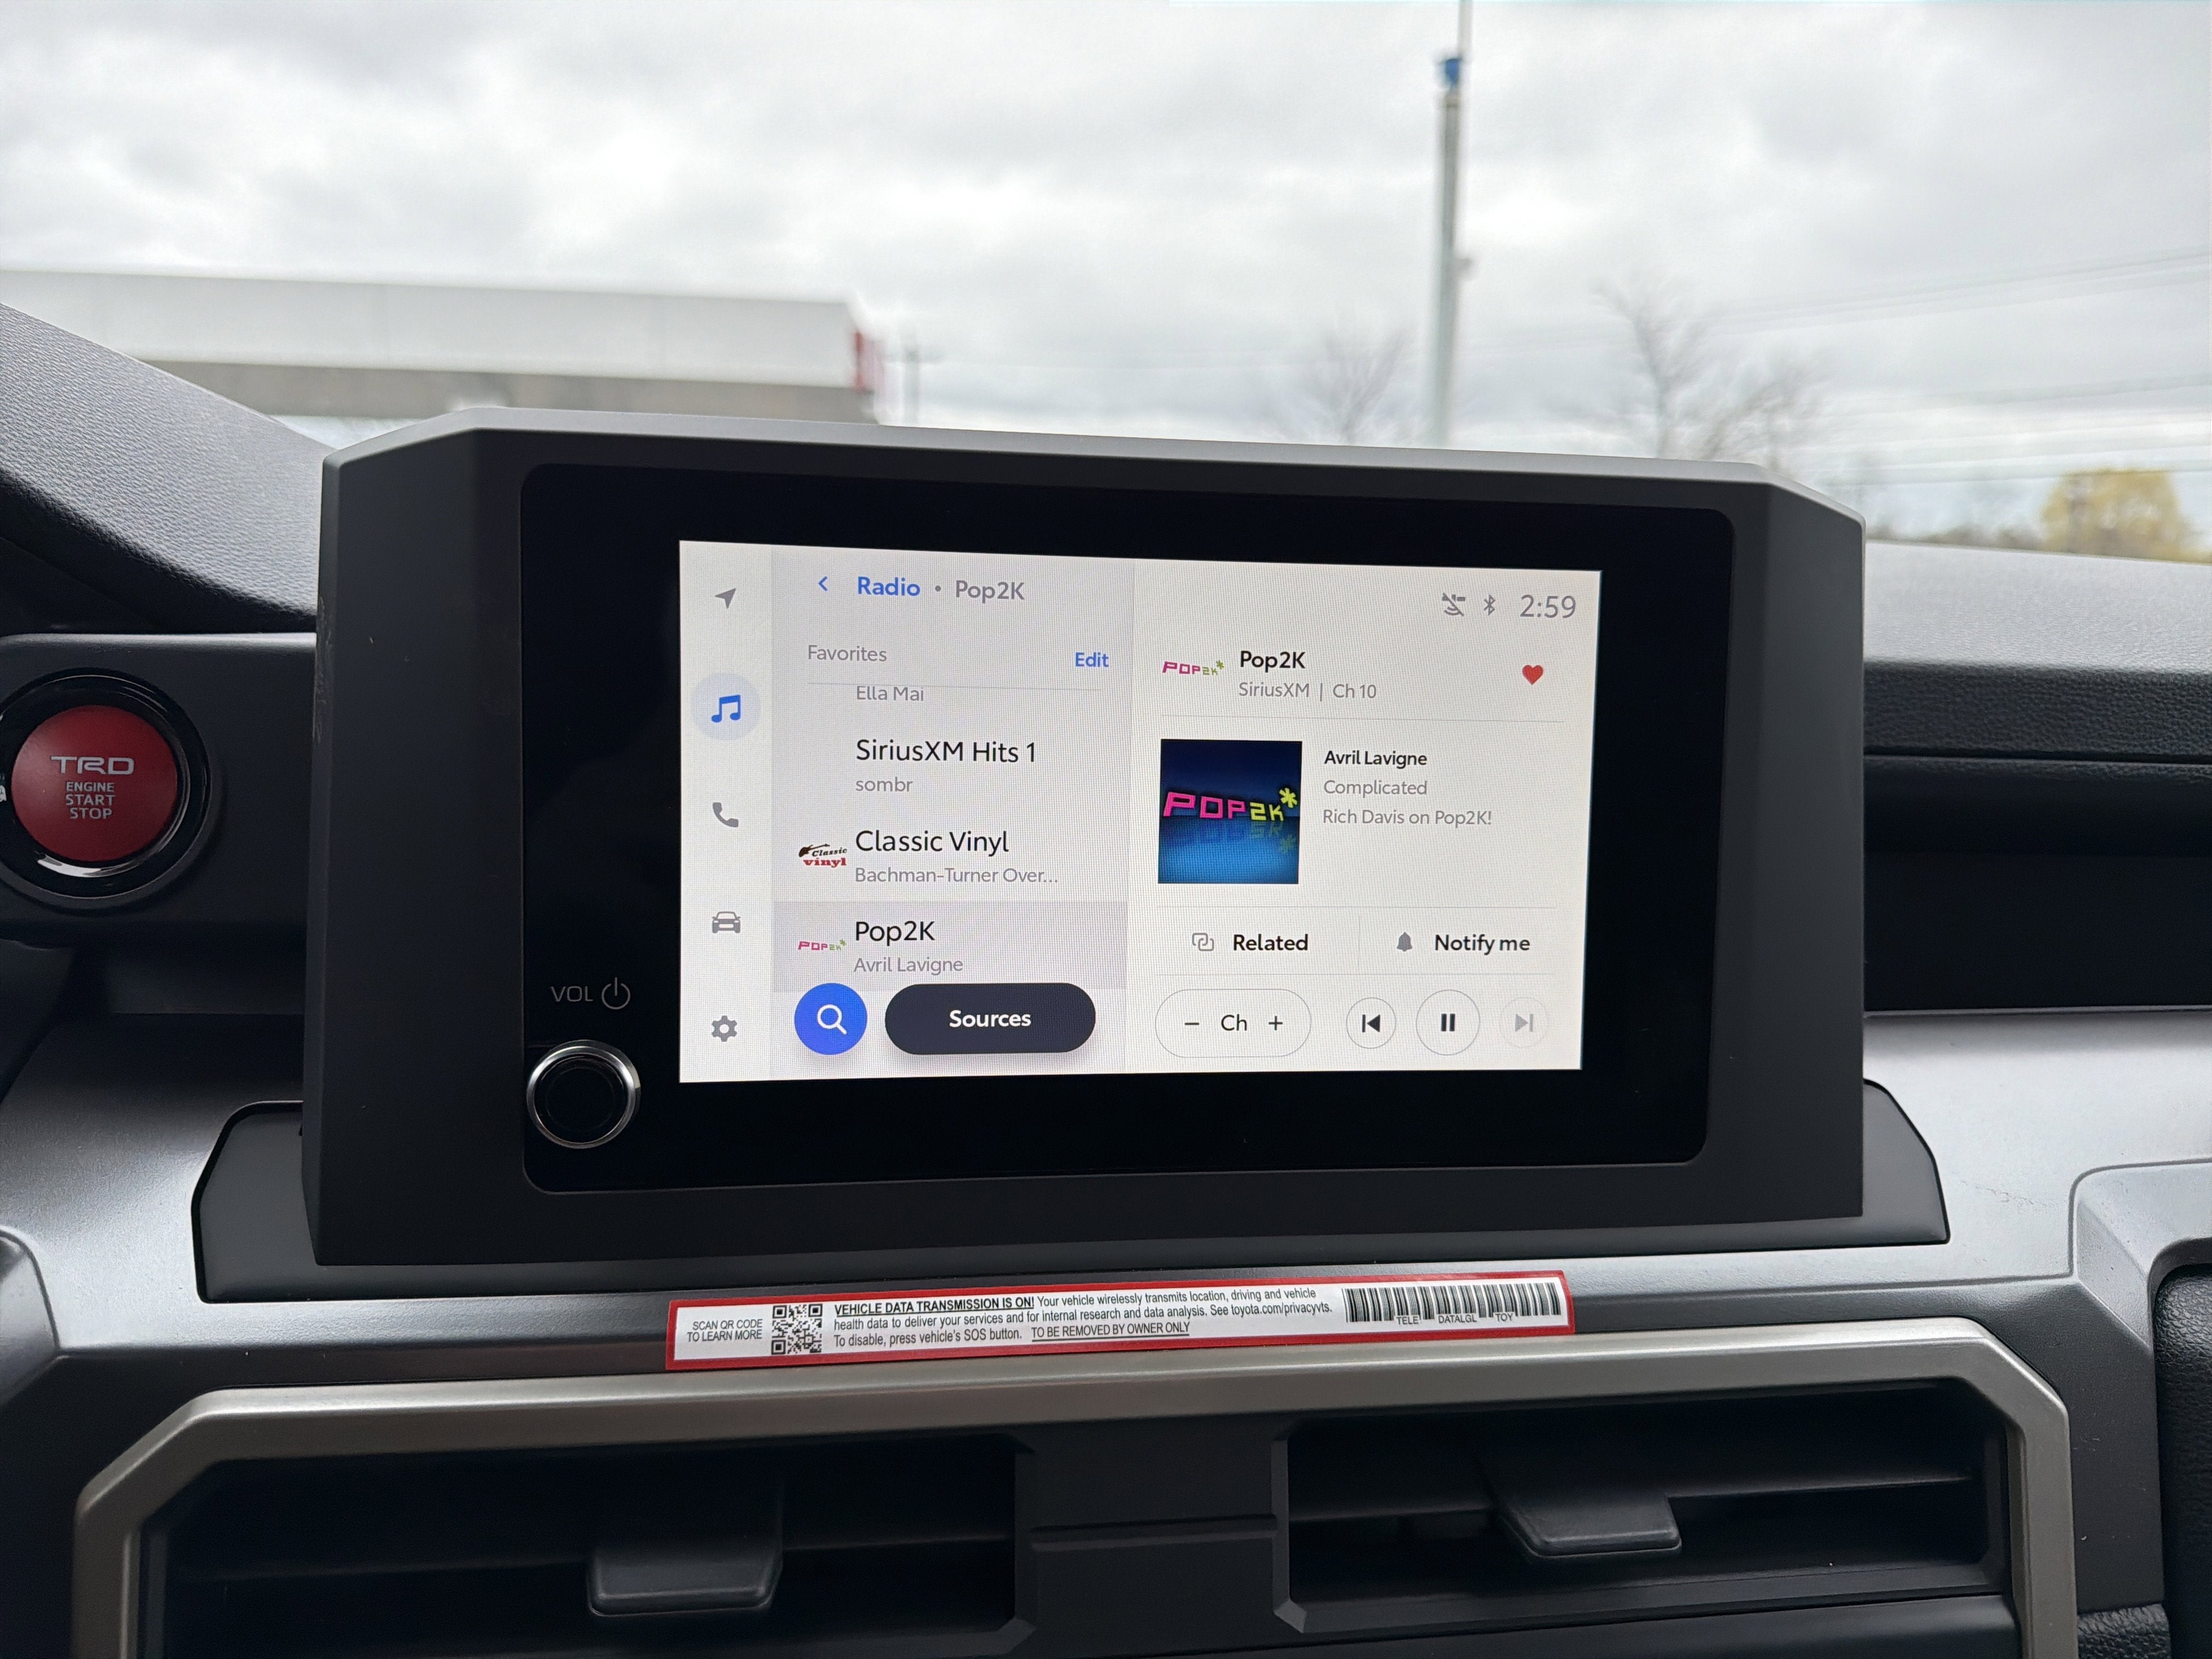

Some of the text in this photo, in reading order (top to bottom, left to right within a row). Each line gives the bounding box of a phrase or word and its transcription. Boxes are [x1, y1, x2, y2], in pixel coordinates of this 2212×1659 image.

[857, 576, 1025, 603] Radio Pop2K
[1520, 595, 1576, 618] 2:59
[808, 645, 887, 662] Favorites
[1075, 652, 1109, 668] Edit
[1240, 651, 1306, 672] Pop2K
[856, 686, 924, 702] Ella Mai
[1239, 682, 1376, 699] SiriusXM Ch 10
[856, 740, 1035, 762] SiriusXM Hits 1
[51, 756, 134, 775] TRD
[1324, 751, 1427, 769] Avril Lavigne
[66, 782, 114, 792] ENGINE
[856, 776, 913, 792] sombr
[1324, 780, 1427, 798] Complicated
[66, 794, 115, 805] START
[70, 808, 112, 819] STOP
[1323, 809, 1491, 828] Rich Davis on Pop2K!
[812, 847, 847, 856] Classic
[856, 830, 1008, 856] Classic Vinyl
[803, 857, 847, 868] vinyl
[856, 867, 1058, 883] Bachman-Turner Over...
[856, 921, 935, 945] Pop2K
[1233, 933, 1308, 951] Related
[1435, 934, 1530, 955] Notify me
[854, 957, 963, 975] Avril Lavigne
[551, 986, 594, 1002] VOL
[950, 1011, 1031, 1027] Sources
[1221, 1014, 1247, 1031] Ch
[834, 1288, 1316, 1315] VEHICLE DATA TRANSMISSION IS ON! Your vehicle wirelessly transmits location, driving and vehicle
[693, 1319, 763, 1330] SCAN QR CODE
[834, 1302, 1332, 1330] health data to deliver your services and for internal research and data analysis. See toyota.com/privacyvts.
[1396, 1312, 1514, 1325] TELE DATALGL TOY
[687, 1329, 762, 1341] TO LEARN MORE
[834, 1335, 845, 1346] To
[849, 1333, 886, 1346] disable,
[890, 1334, 916, 1347] press
[964, 1329, 986, 1341] SOS
[990, 1328, 1022, 1340] button.
[1031, 1327, 1044, 1338] TO
[1047, 1327, 1059, 1337] BE
[1063, 1324, 1110, 1336] REMOVED
[1113, 1324, 1125, 1334] BY
[1127, 1323, 1163, 1334] OWNER
[1166, 1322, 1190, 1333] ONLY
